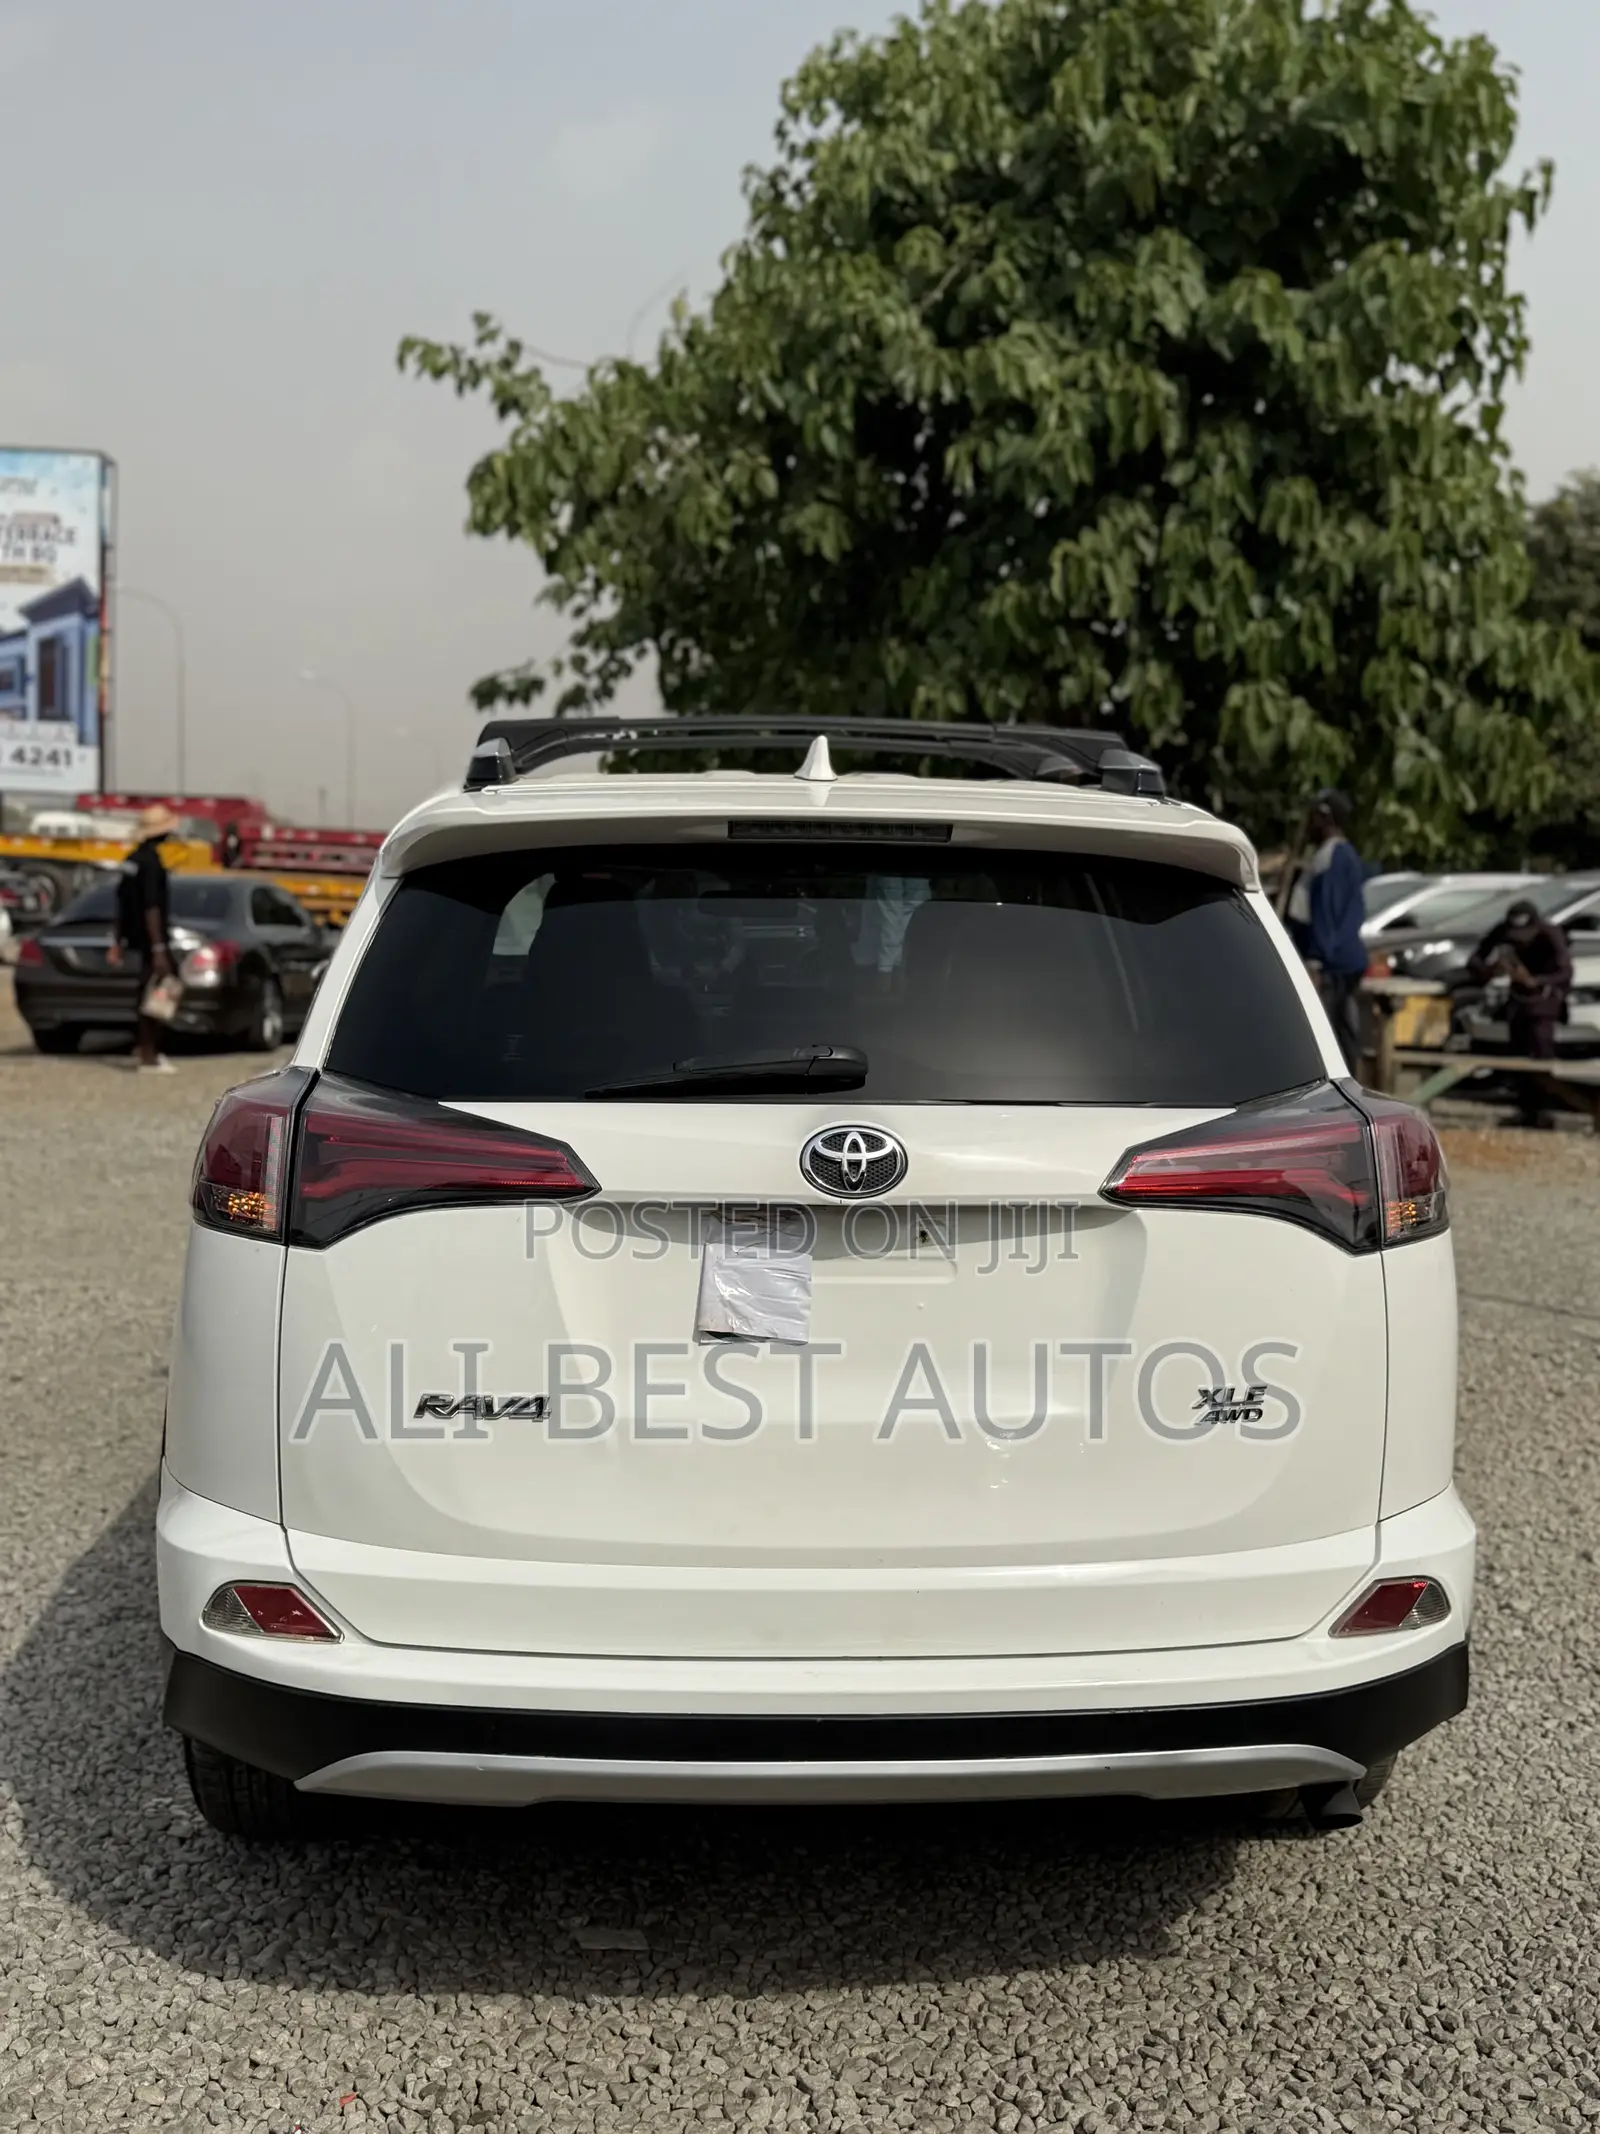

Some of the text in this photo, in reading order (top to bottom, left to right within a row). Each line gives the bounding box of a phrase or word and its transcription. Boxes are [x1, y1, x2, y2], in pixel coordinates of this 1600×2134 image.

[10, 746, 73, 769] 4241
[413, 1393, 552, 1423] RAV4
[1192, 1386, 1267, 1409] XLE
[1195, 1408, 1264, 1425] AWD
